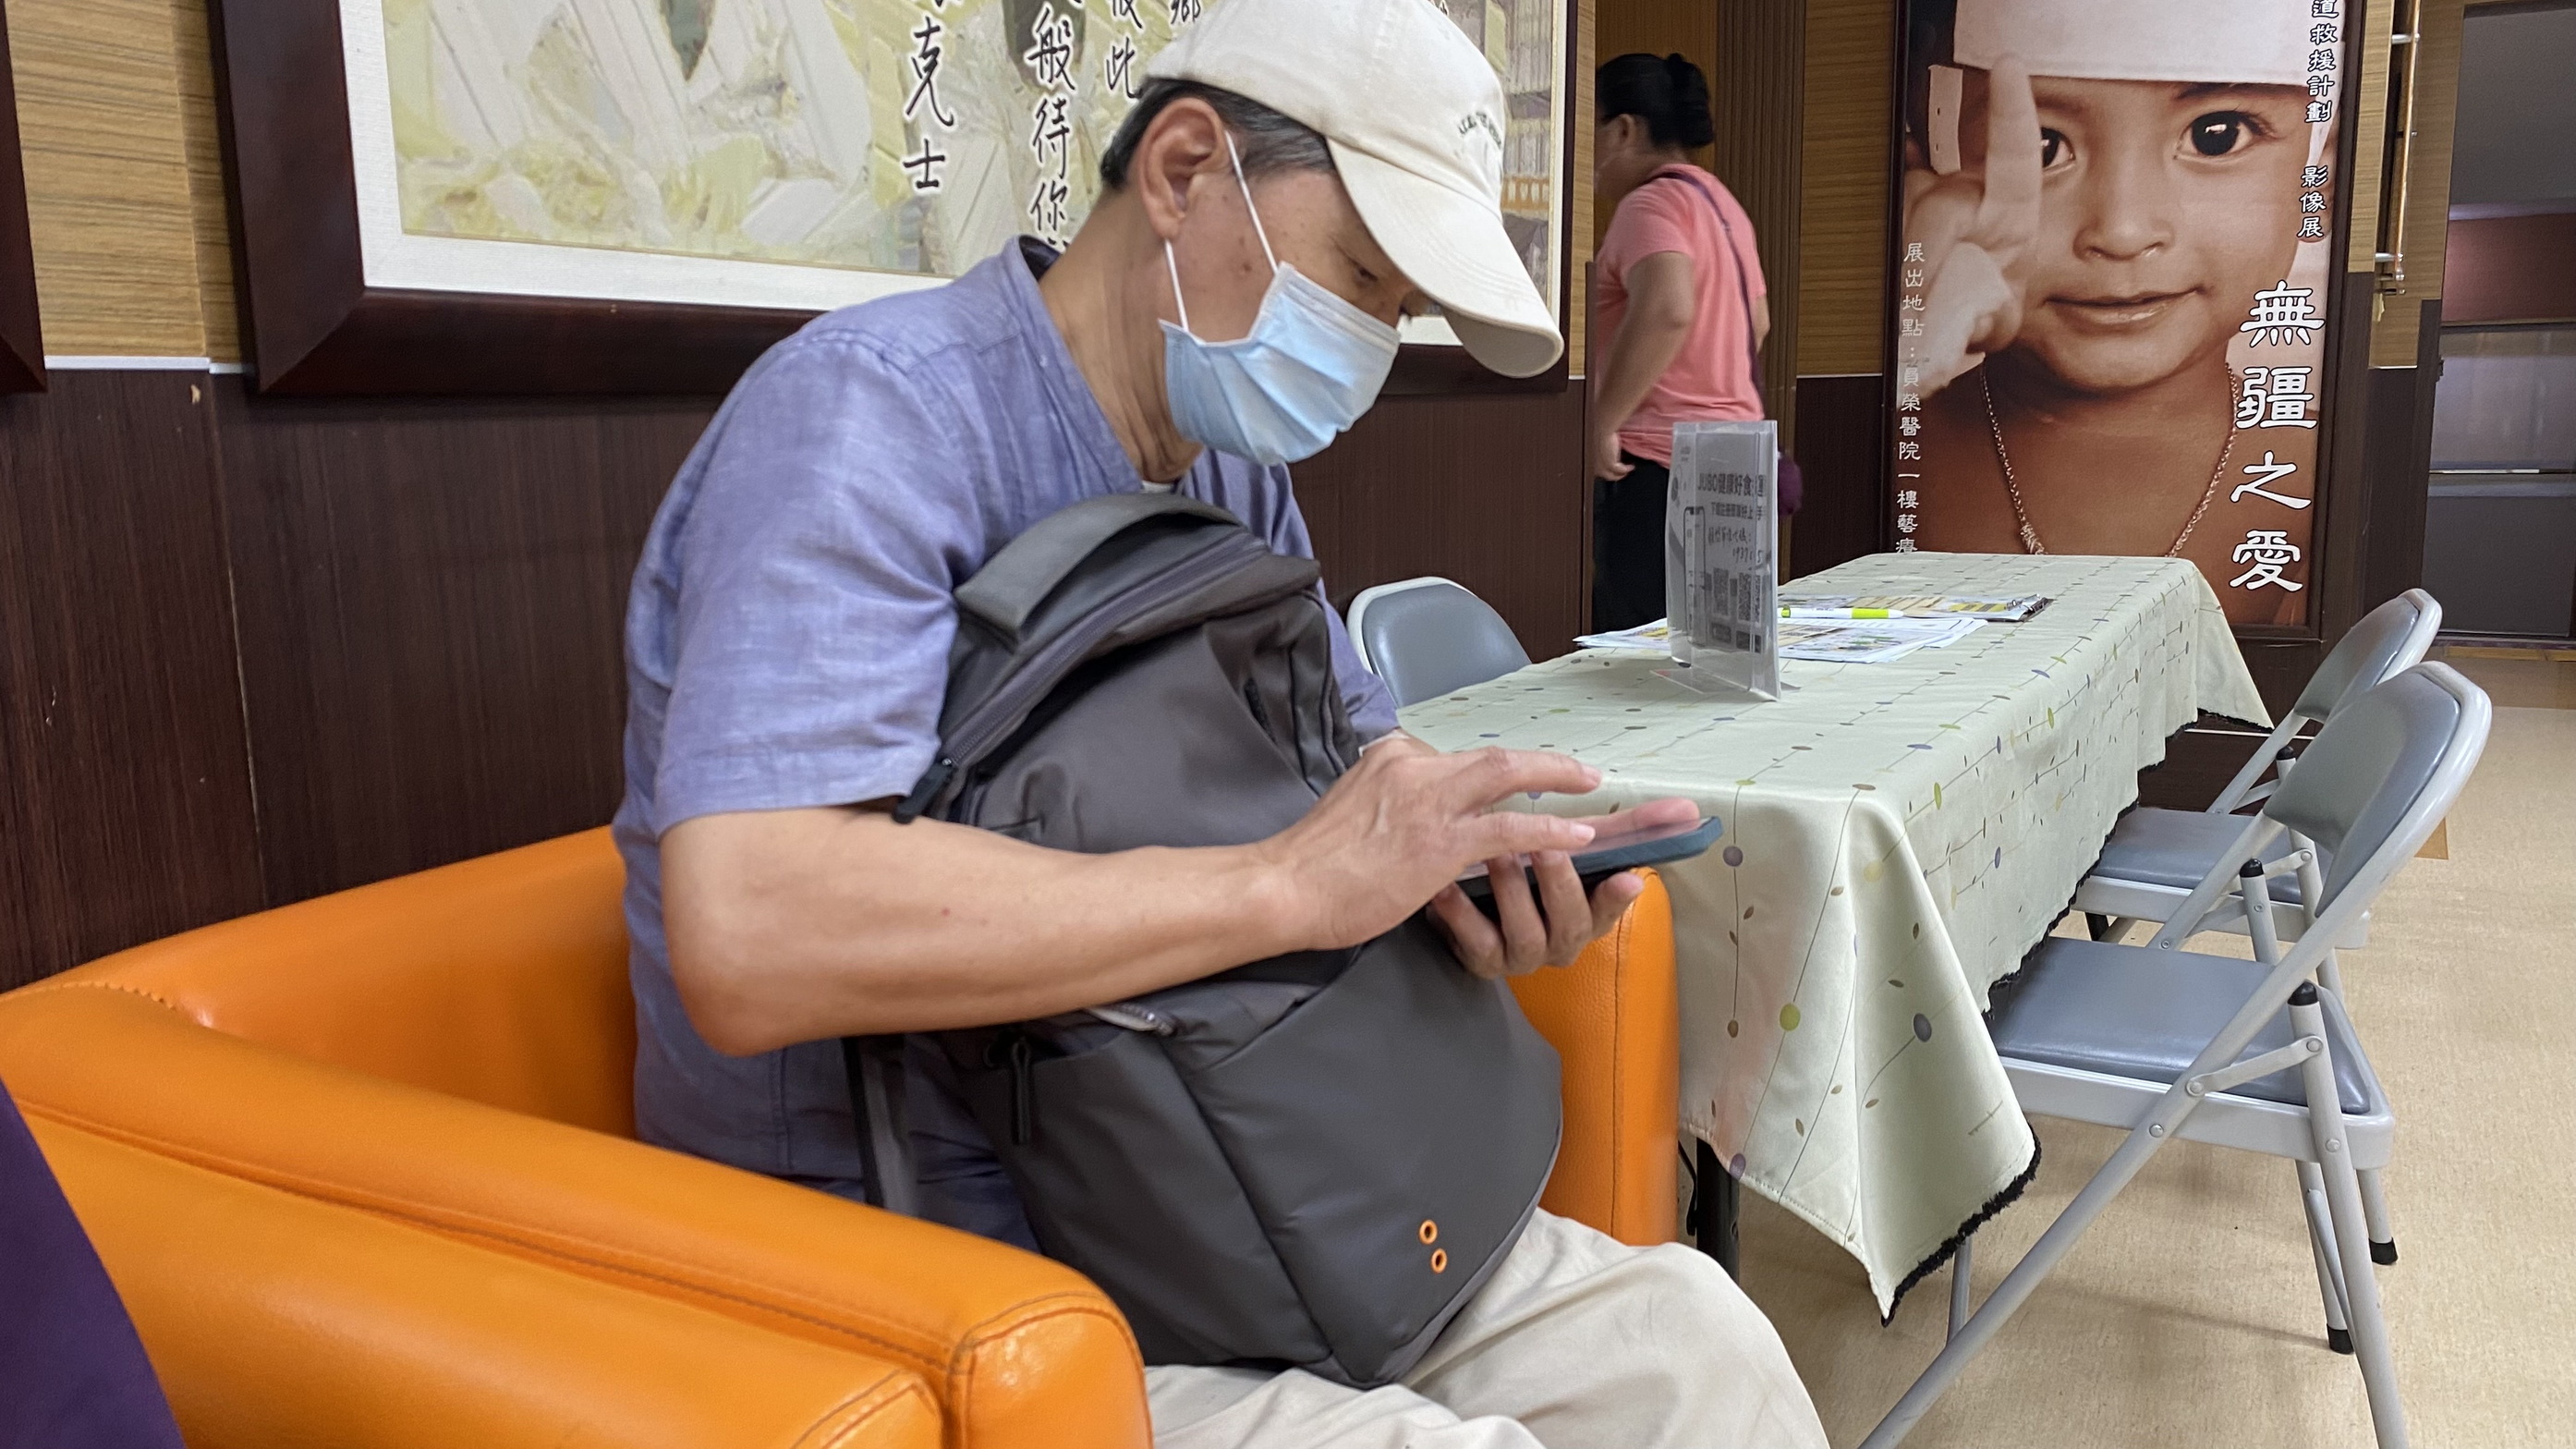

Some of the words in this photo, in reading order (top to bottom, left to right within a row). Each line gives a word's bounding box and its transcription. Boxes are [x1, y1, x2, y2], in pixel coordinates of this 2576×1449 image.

[903, 0, 955, 189] 克士
[2297, 164, 2328, 237] 影像展
[2229, 279, 2326, 592] 無疆之愛
